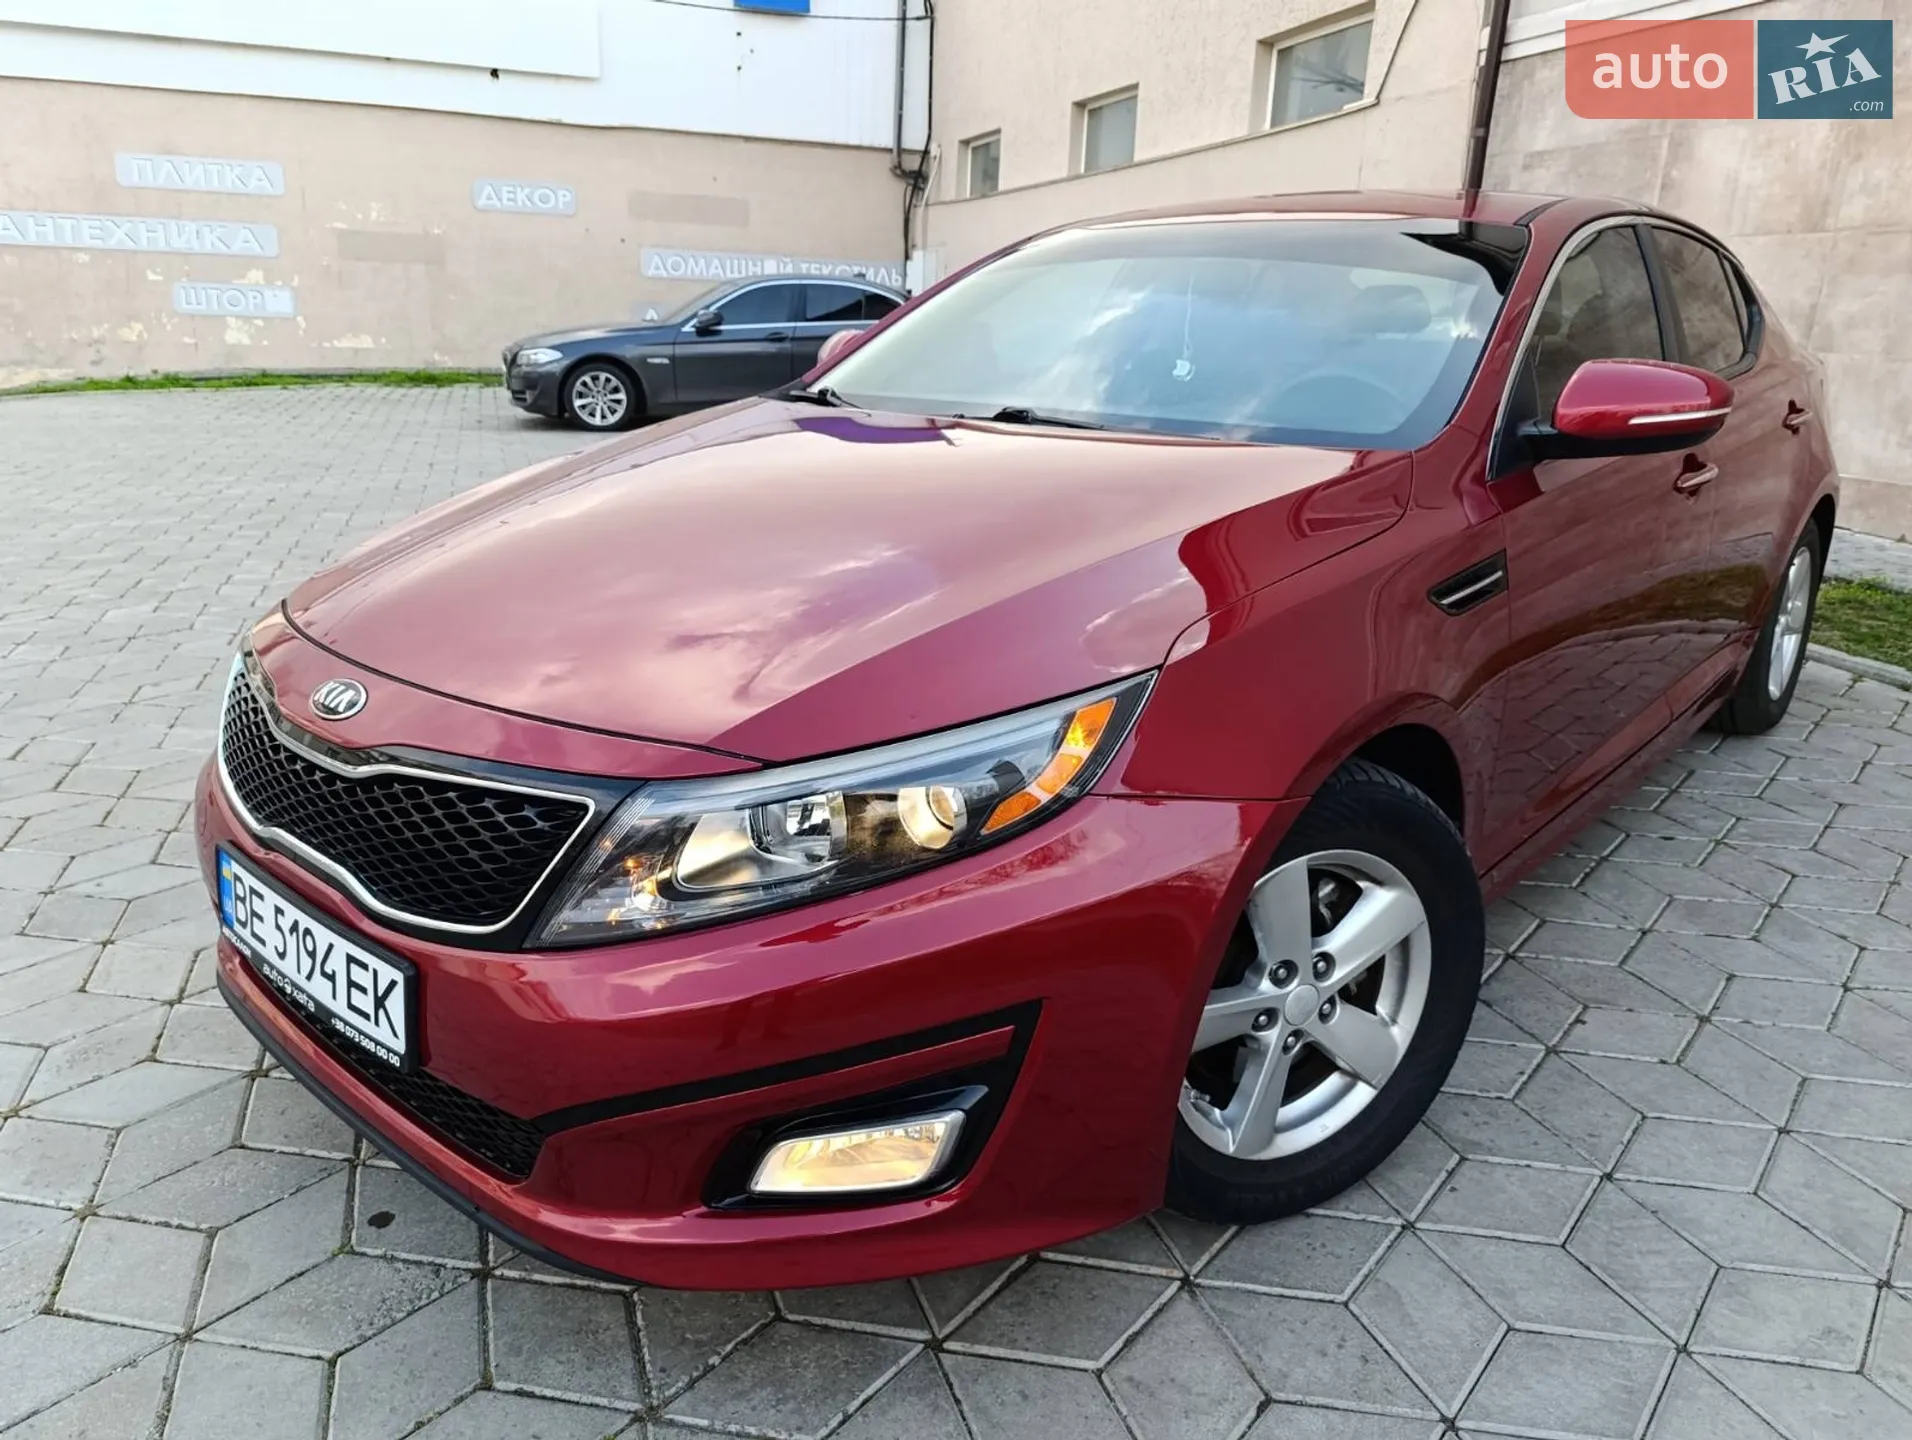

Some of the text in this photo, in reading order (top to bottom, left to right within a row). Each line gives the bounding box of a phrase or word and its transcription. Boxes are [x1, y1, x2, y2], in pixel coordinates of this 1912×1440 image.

[131, 157, 274, 192] ПЛИТКА
[478, 183, 572, 209] ДЕКОР
[648, 253, 793, 278] ДОМАШНЙ
[180, 286, 290, 312] ШТОР
[233, 871, 400, 1040] BE 5194 EK
[376, 1045, 388, 1060] 00
[389, 1052, 400, 1067] 00
